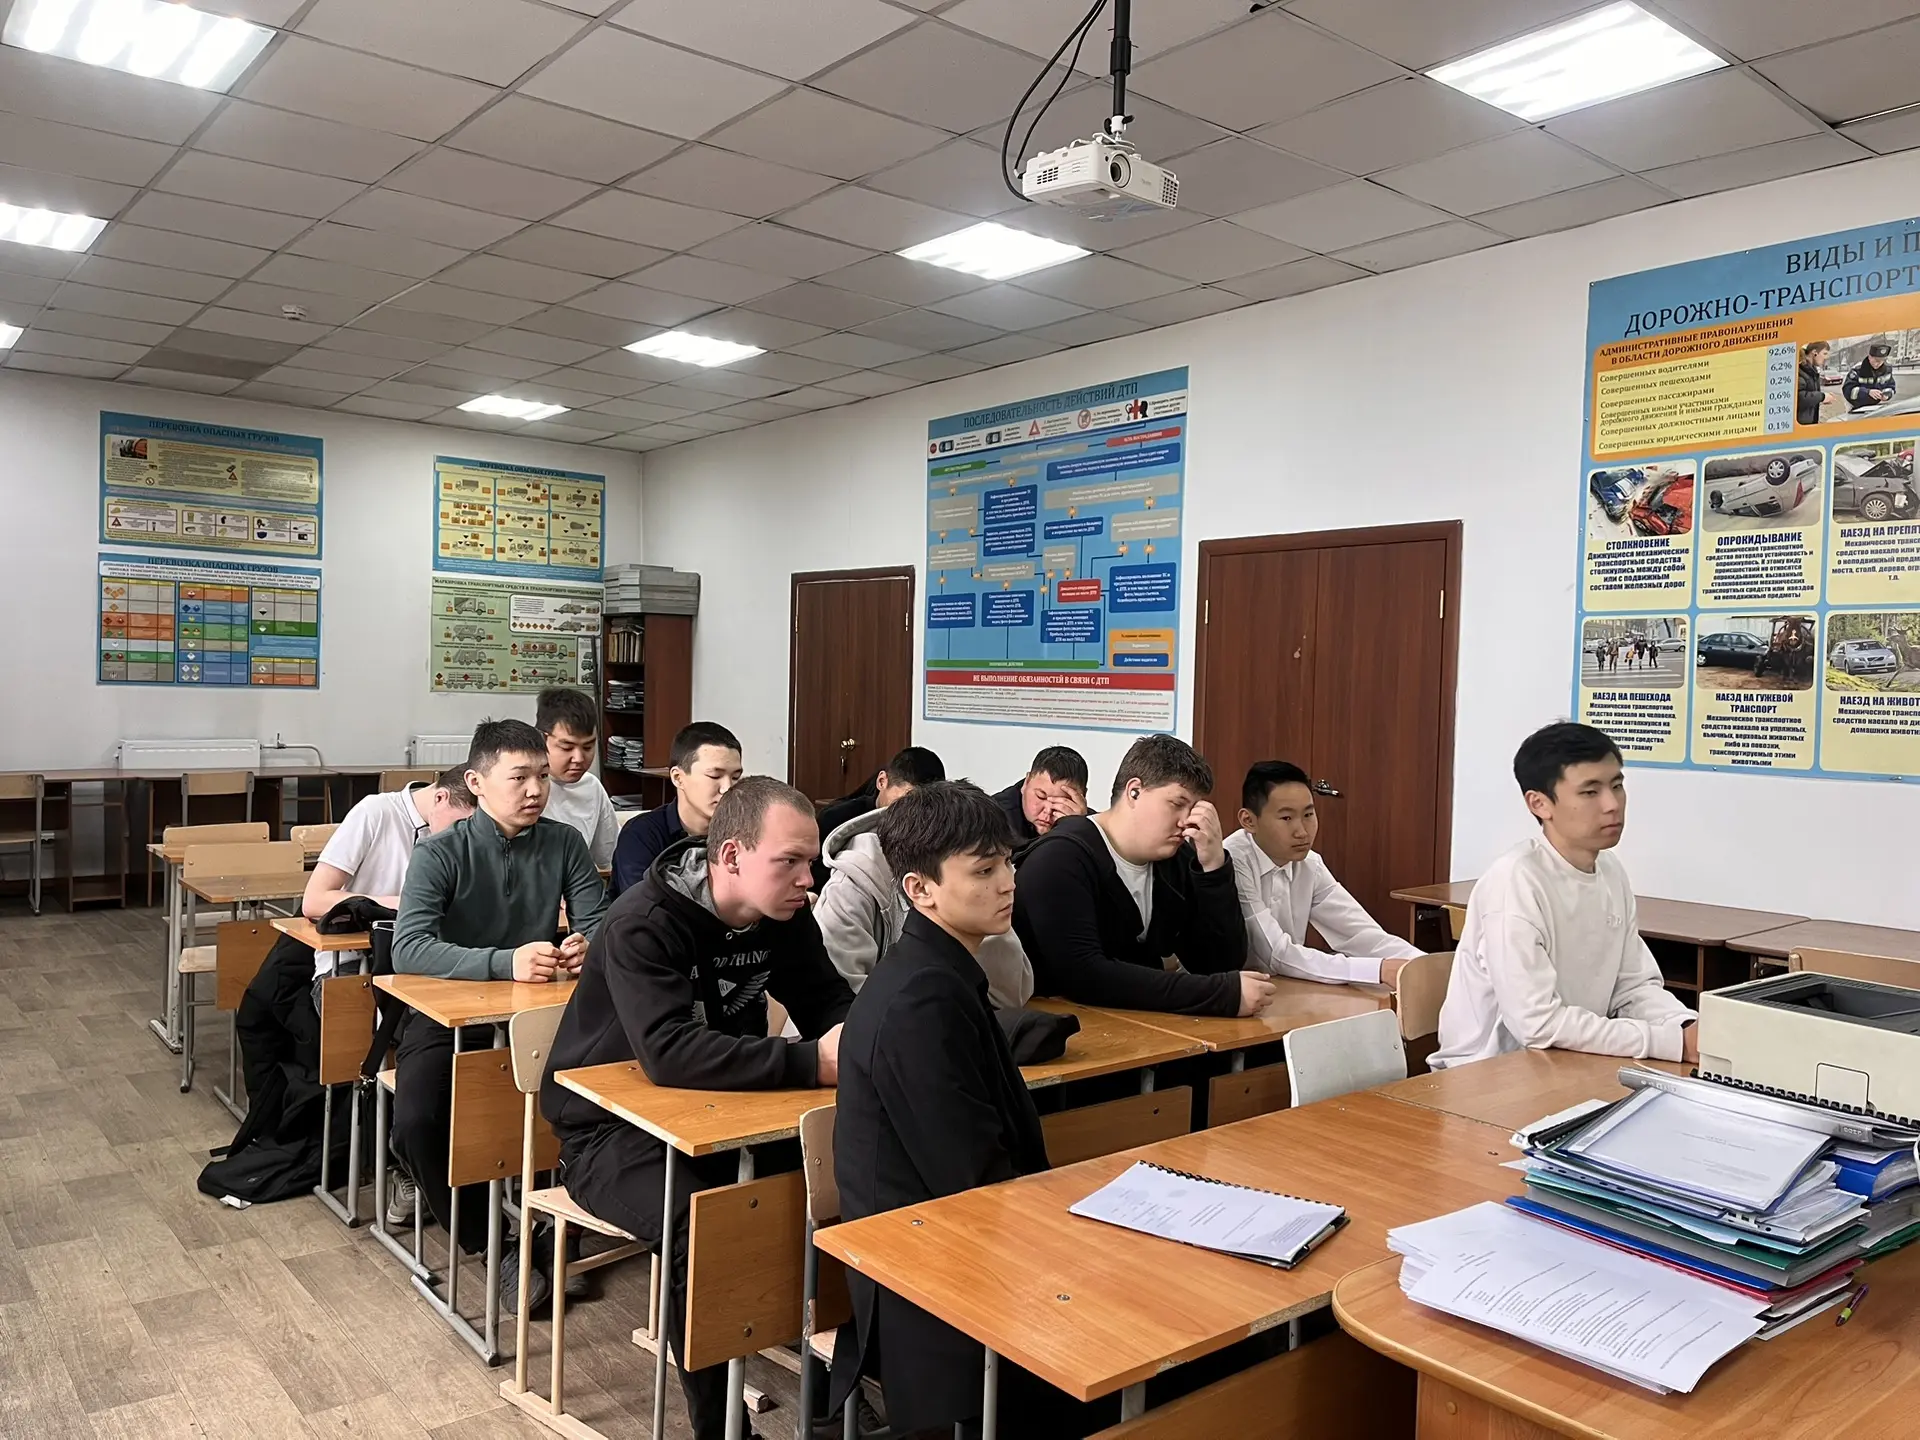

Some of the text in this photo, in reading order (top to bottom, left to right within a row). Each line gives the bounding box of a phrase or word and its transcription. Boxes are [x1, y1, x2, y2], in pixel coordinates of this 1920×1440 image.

[1786, 241, 1865, 275] ВИДЫ
[1874, 236, 1894, 259] И
[1624, 264, 1920, 338] ДОРОЖНО-ТРАНСПОРТ
[1599, 318, 1793, 357] АДМИНИСТРАТИВНЫЕ ПРАВОНАРУШЕНИЯ
[1611, 331, 1779, 365] В ОБЛАСТИ ДОРОЖНОГО ДВИЖЕНИЯ
[1599, 346, 1796, 383] Совершенных водителями 92,6%
[1601, 362, 1793, 395] Совершенных пешеходами 6,2%
[963, 398, 1063, 428] ПОСЛЕДОВАТЕЛЬНОСТЬ
[1064, 384, 1116, 409] ДЕЙСТВИЙ
[1117, 382, 1139, 396] ДТП
[1600, 376, 1792, 409] Совершенных пассажирами 0,2%
[1600, 391, 1791, 420] Совершенных иными участниками 0,6%
[1600, 415, 1639, 426] дорожного
[1640, 409, 1678, 421] движения
[1685, 405, 1713, 414] иными
[1713, 399, 1763, 412] гражданами
[148, 420, 280, 443] ПЕРЕВОЗКА ОПАСНЫХ ГРУЗОВ
[1600, 406, 1791, 436] Совершенных должностными лицами 0,3%
[1598, 421, 1790, 450] Совершенных юридическими лицами 0,1%
[1606, 538, 1670, 551] СТОЛКНОВЕНИЕ
[1717, 532, 1803, 546] ОПРОКИДЫВАНИЕ
[1840, 527, 1871, 538] НАЕЗД
[1873, 526, 1885, 536] НА
[1589, 563, 1686, 575] столкнулись между собой
[1594, 556, 1682, 567] транспортные средства
[1624, 573, 1670, 582] подвижным
[973, 674, 1110, 686] НЕ ВЫПОЛНЕНИЕ ОБЯЗАННОСТЕЙ В СВЯЗИ С ДТП
[1592, 692, 1671, 703] НАЕЗД НА ПЕШЕХОДА
[1715, 692, 1794, 703] НАЕЗД НА ГУЖЕВОЙ
[1730, 704, 1777, 714] ТРАНСПОРТ
[1840, 696, 1871, 706] НАЕЗД
[1872, 696, 1885, 706] НА
